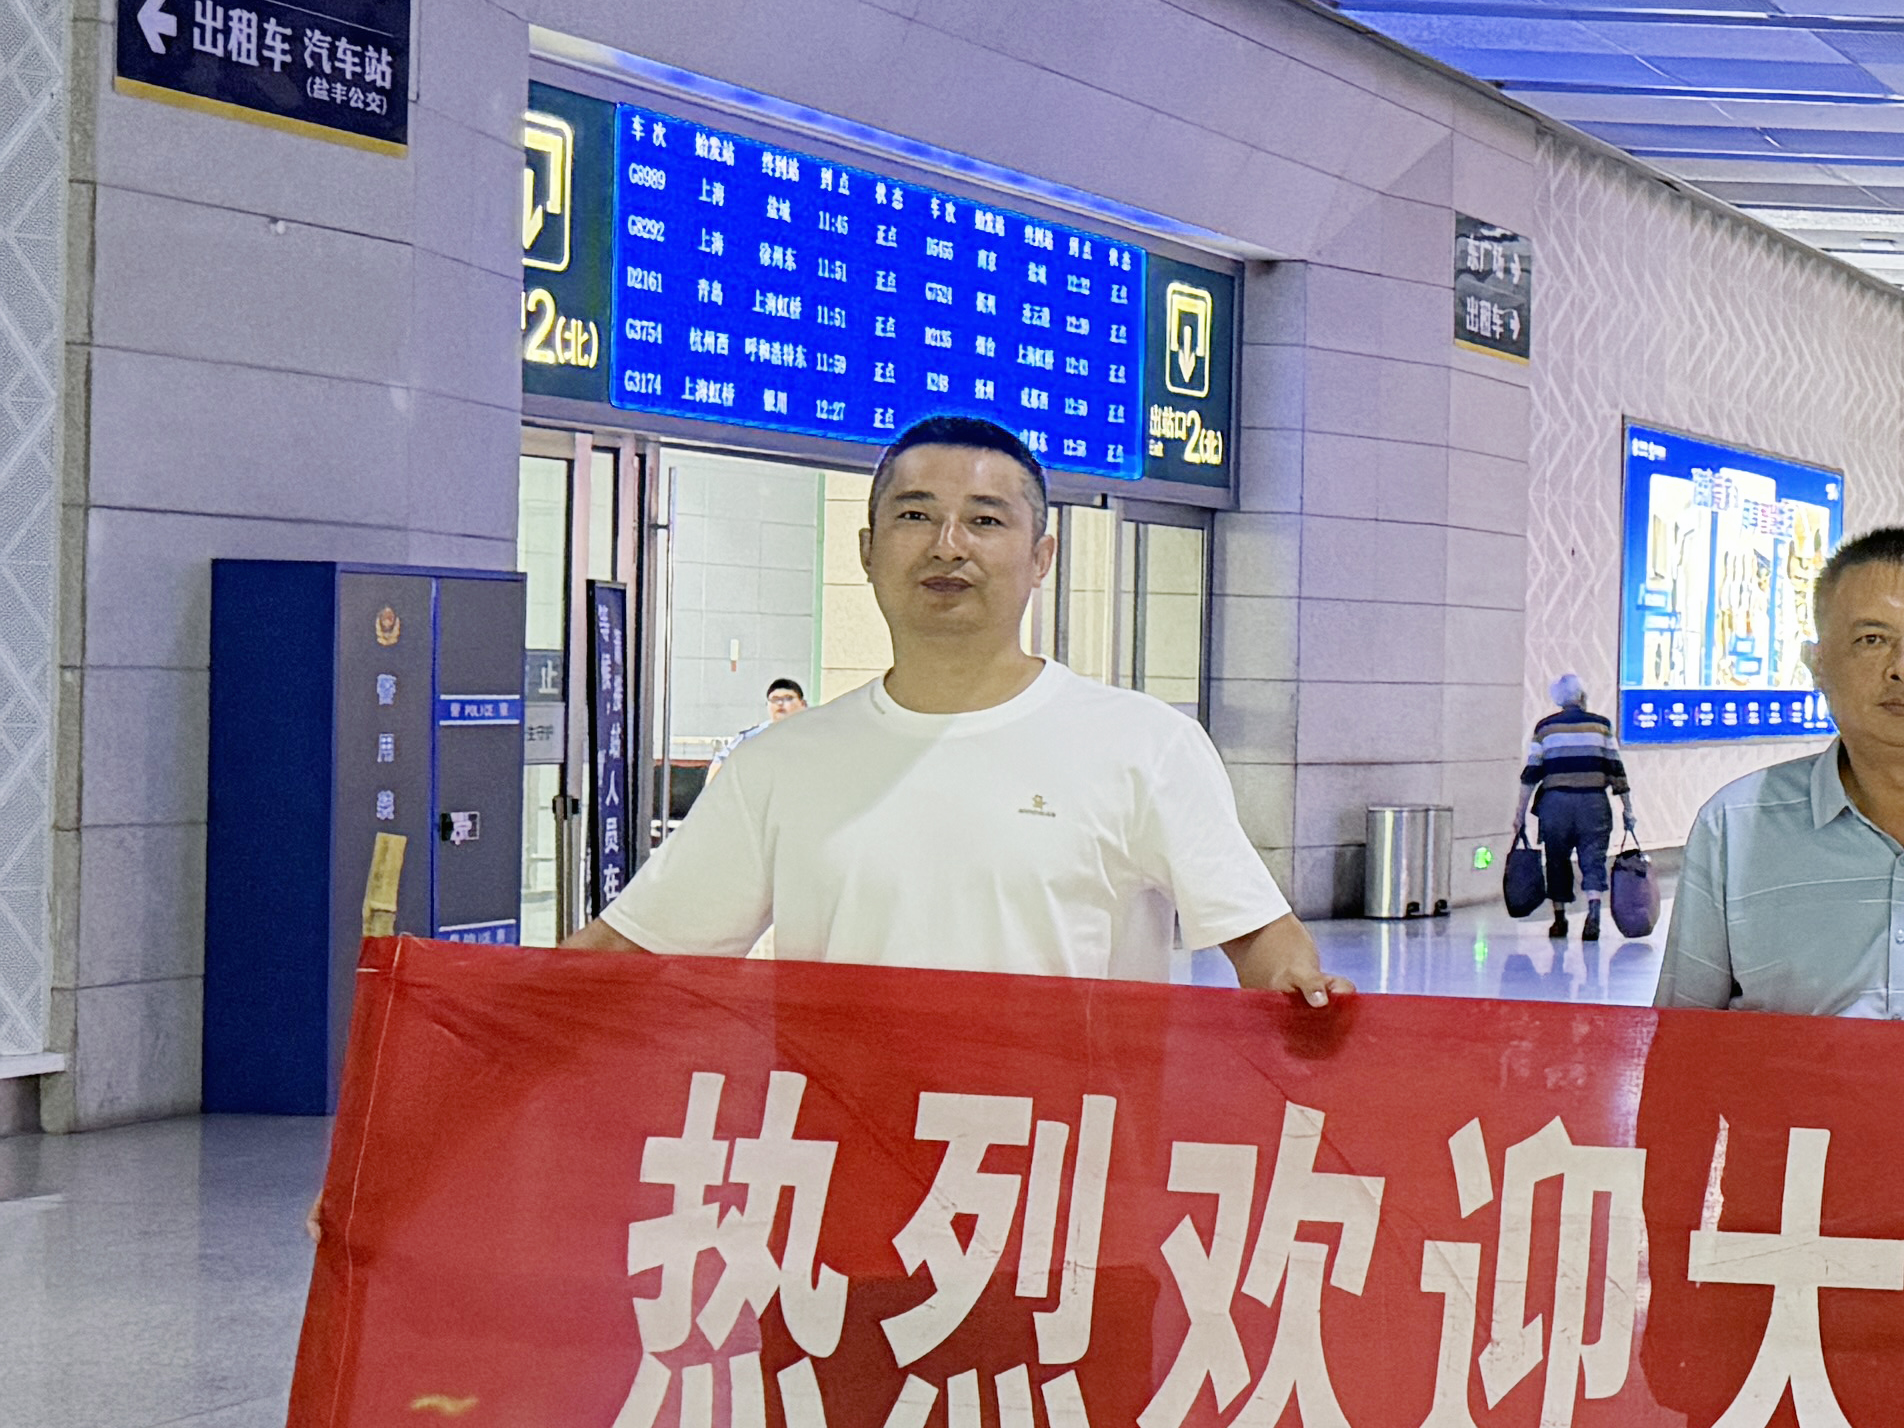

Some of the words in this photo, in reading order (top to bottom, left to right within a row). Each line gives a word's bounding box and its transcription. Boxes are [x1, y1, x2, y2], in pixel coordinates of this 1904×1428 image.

[193, 0, 292, 72] 出租车
[302, 28, 393, 90] 汽车站
[305, 76, 387, 116] (盐丰公交)
[626, 265, 663, 293] D2161
[625, 318, 662, 345] G3754
[624, 369, 662, 395] G3174
